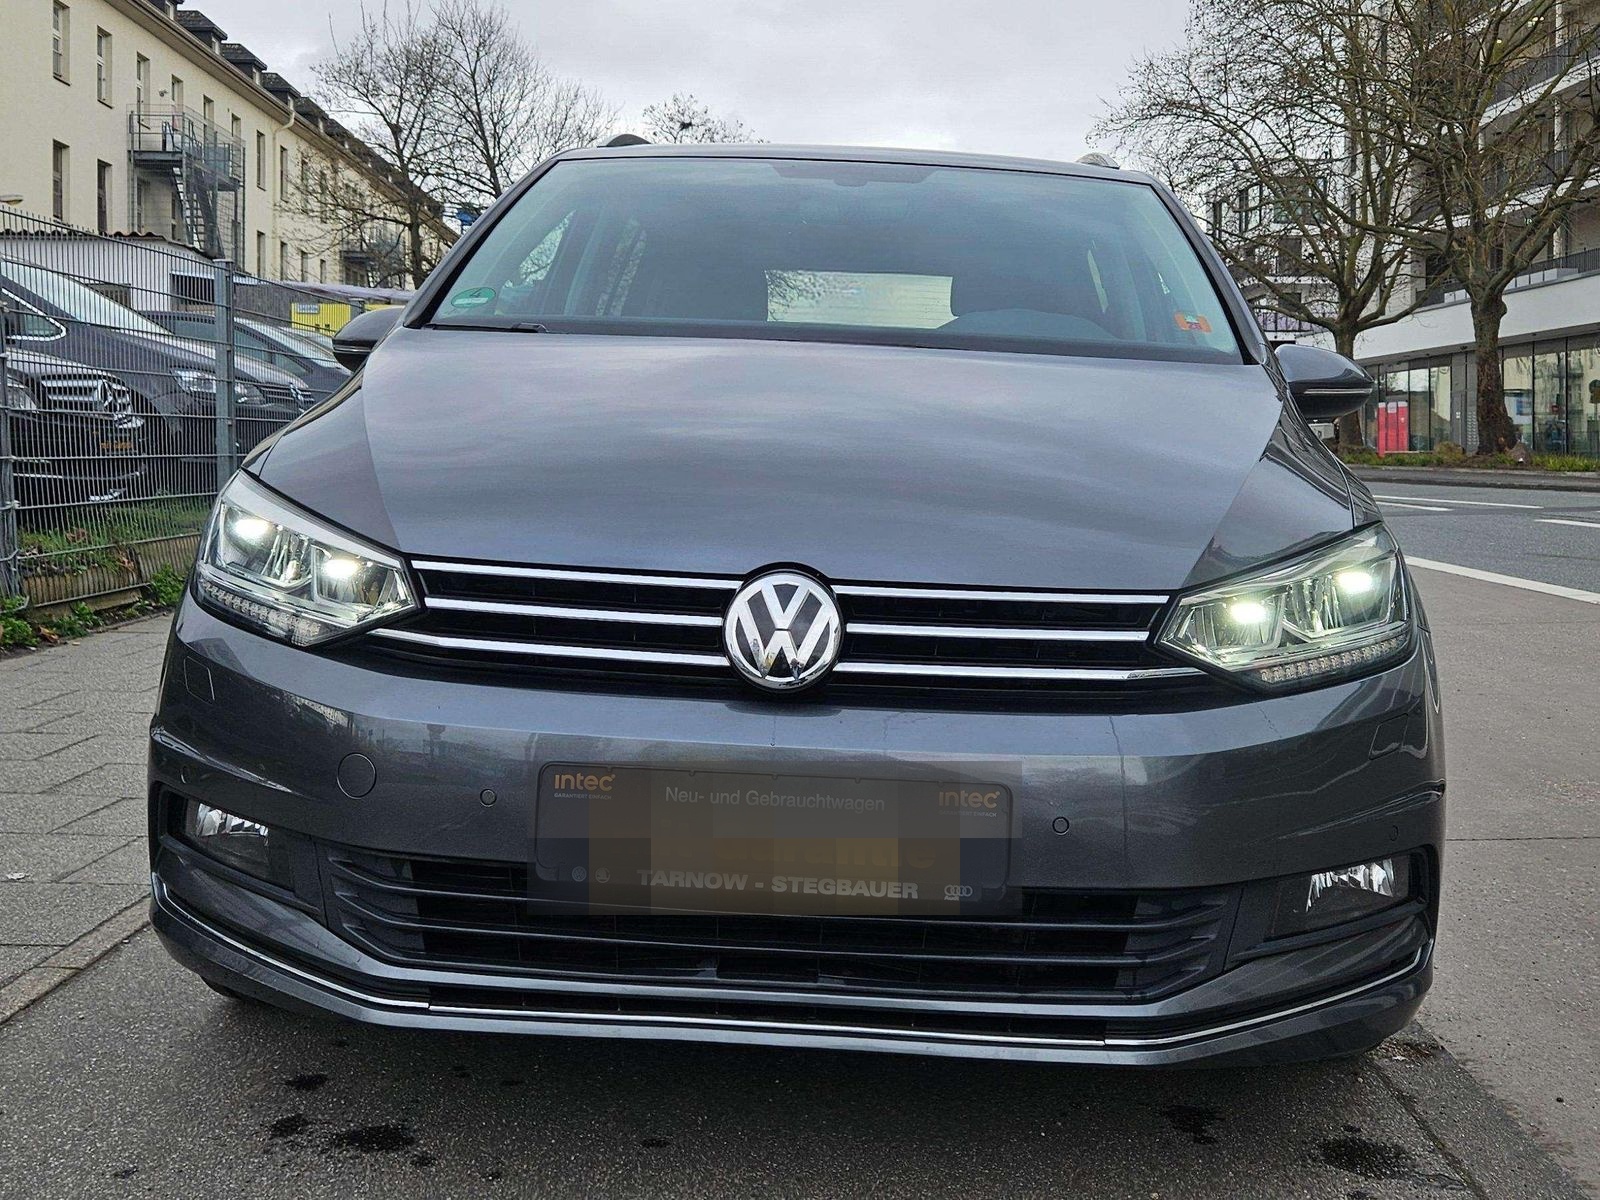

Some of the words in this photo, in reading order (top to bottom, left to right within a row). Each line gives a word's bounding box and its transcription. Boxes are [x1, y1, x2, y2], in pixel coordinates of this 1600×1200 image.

[554, 773, 616, 791] intec
[665, 787, 704, 803] Neu-
[710, 790, 740, 805] und
[745, 790, 885, 813] Gebrauchtwagen
[938, 790, 1001, 809] intec
[636, 868, 749, 891] TARNOW
[771, 875, 919, 900] STEGBAUER
